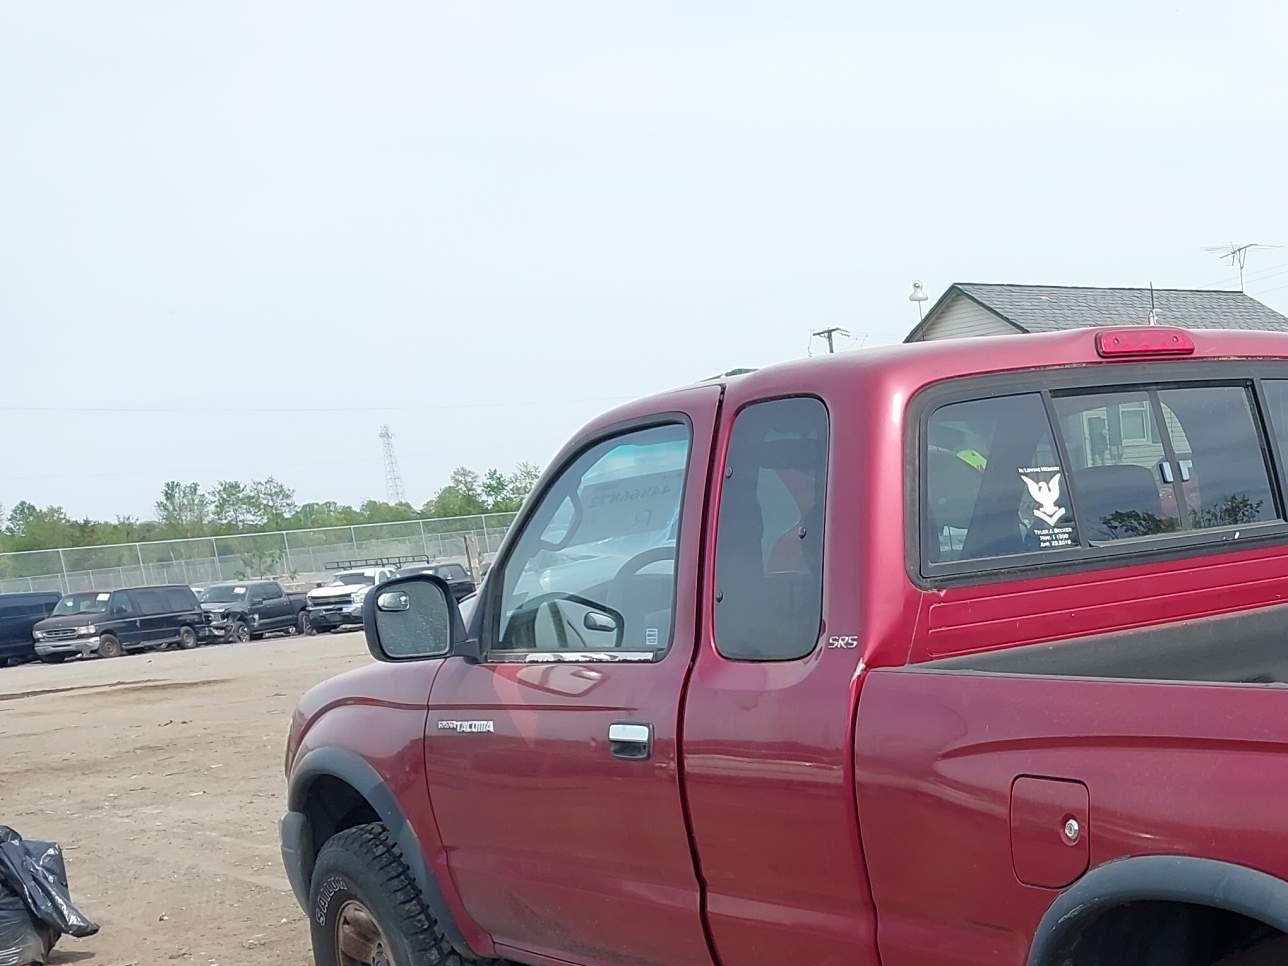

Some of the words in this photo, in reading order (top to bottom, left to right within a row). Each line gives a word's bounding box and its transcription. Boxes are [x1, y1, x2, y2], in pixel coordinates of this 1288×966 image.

[828, 635, 859, 649] SR5
[456, 720, 495, 733] TACOMA
[315, 875, 348, 927] SAILUN
